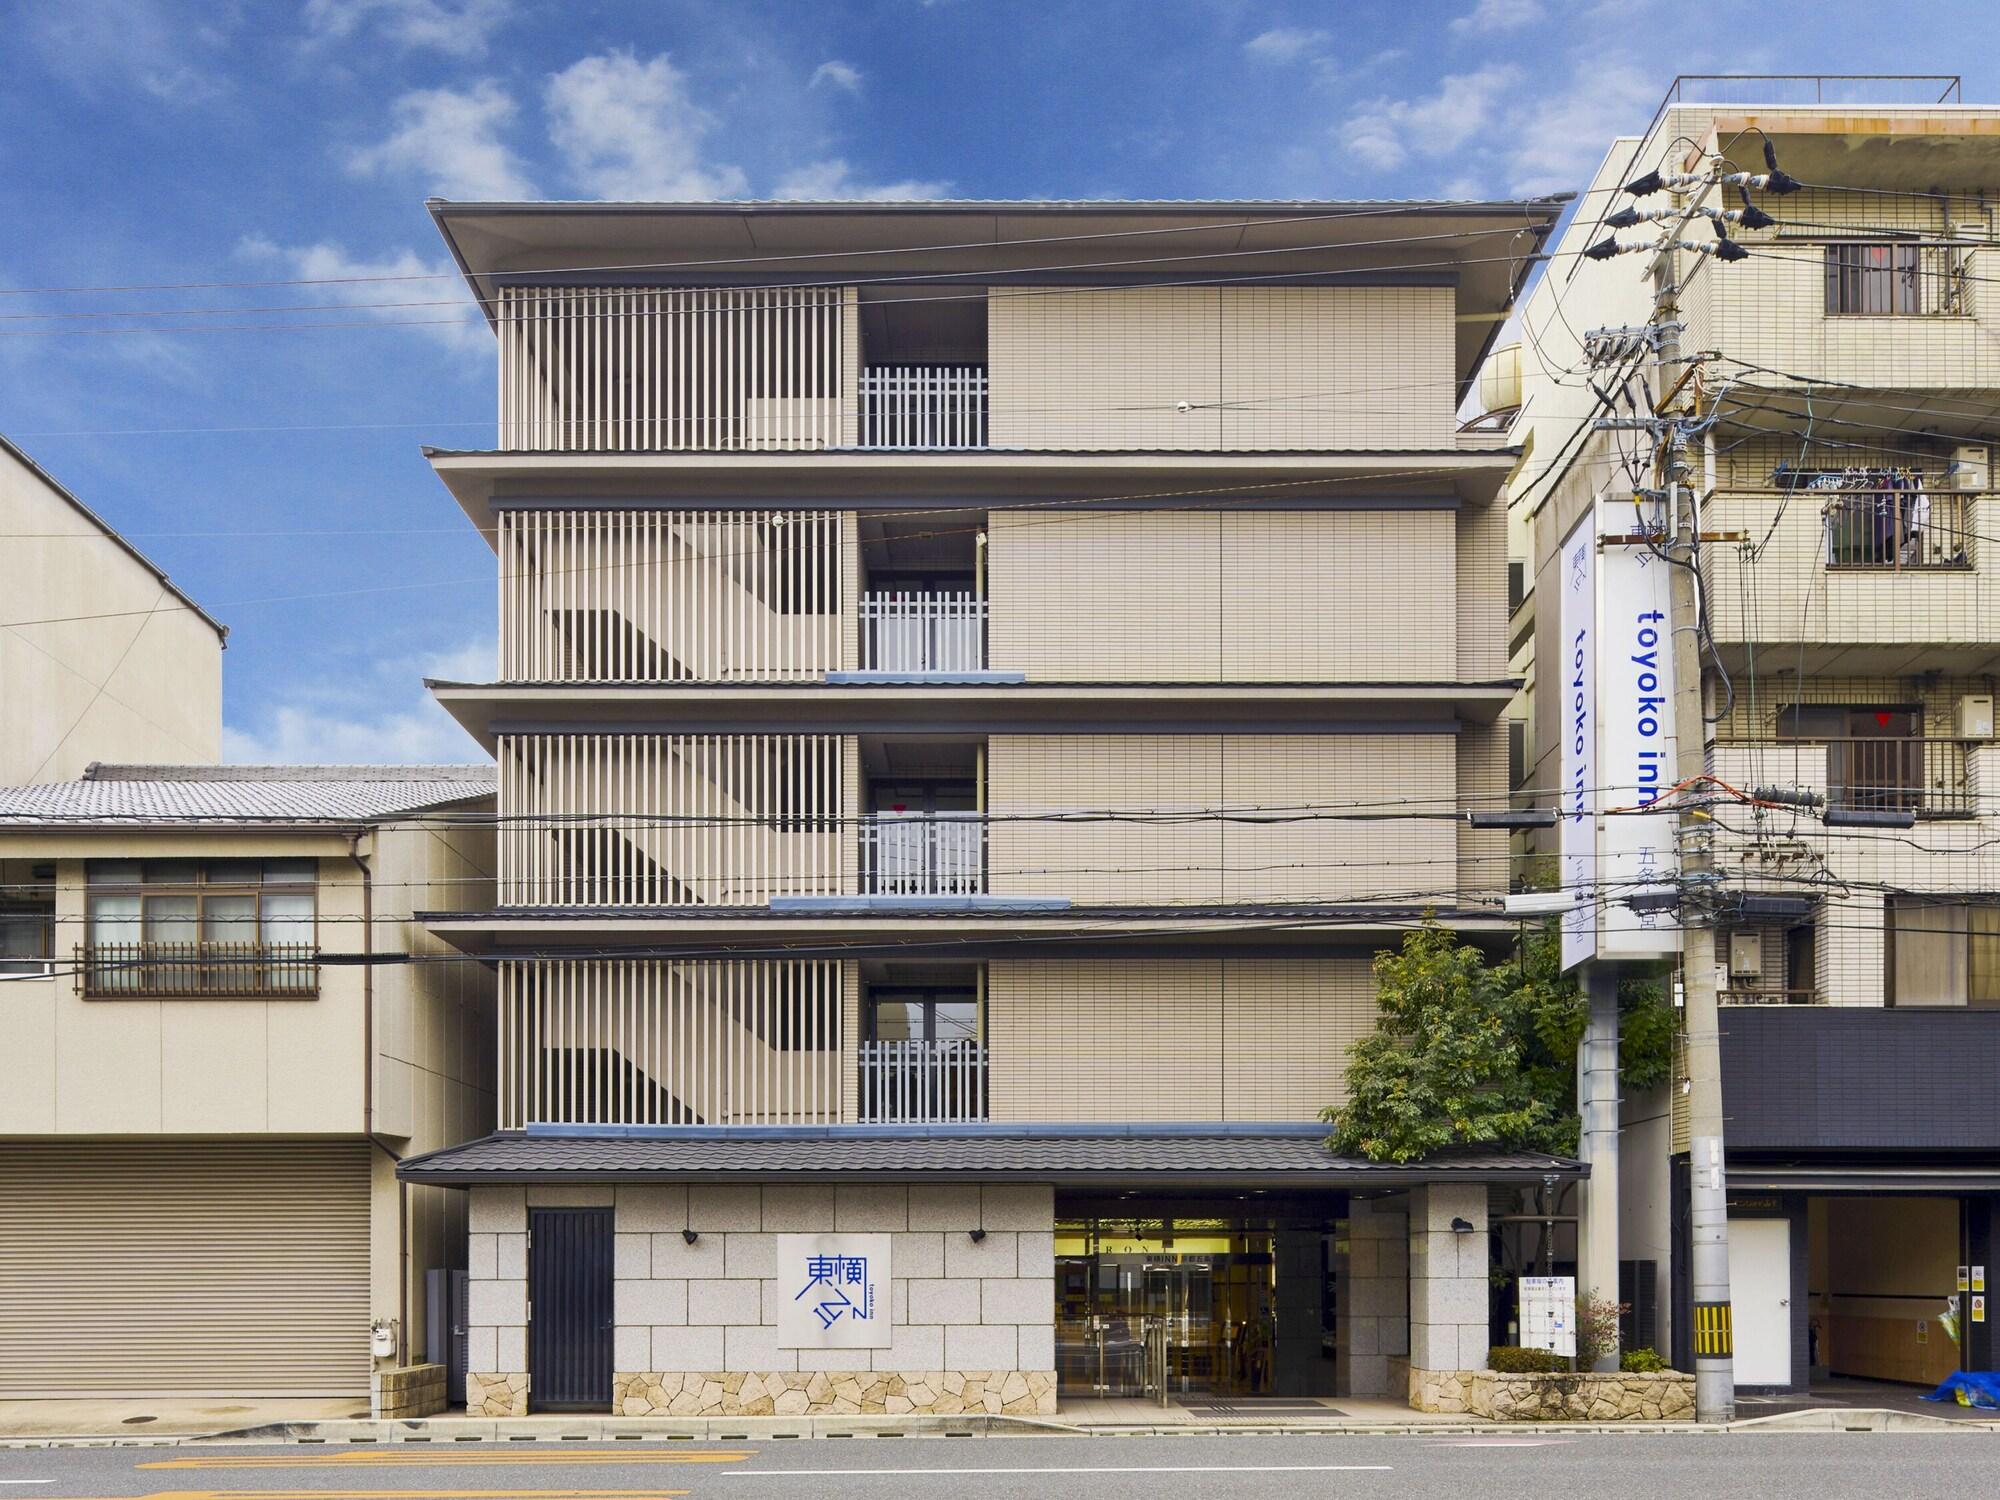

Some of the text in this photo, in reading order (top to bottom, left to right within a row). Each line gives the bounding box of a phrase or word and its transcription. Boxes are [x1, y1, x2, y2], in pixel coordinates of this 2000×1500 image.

[1573, 628, 1586, 823] toyoko inn
[1631, 609, 1665, 806] toyoko inn
